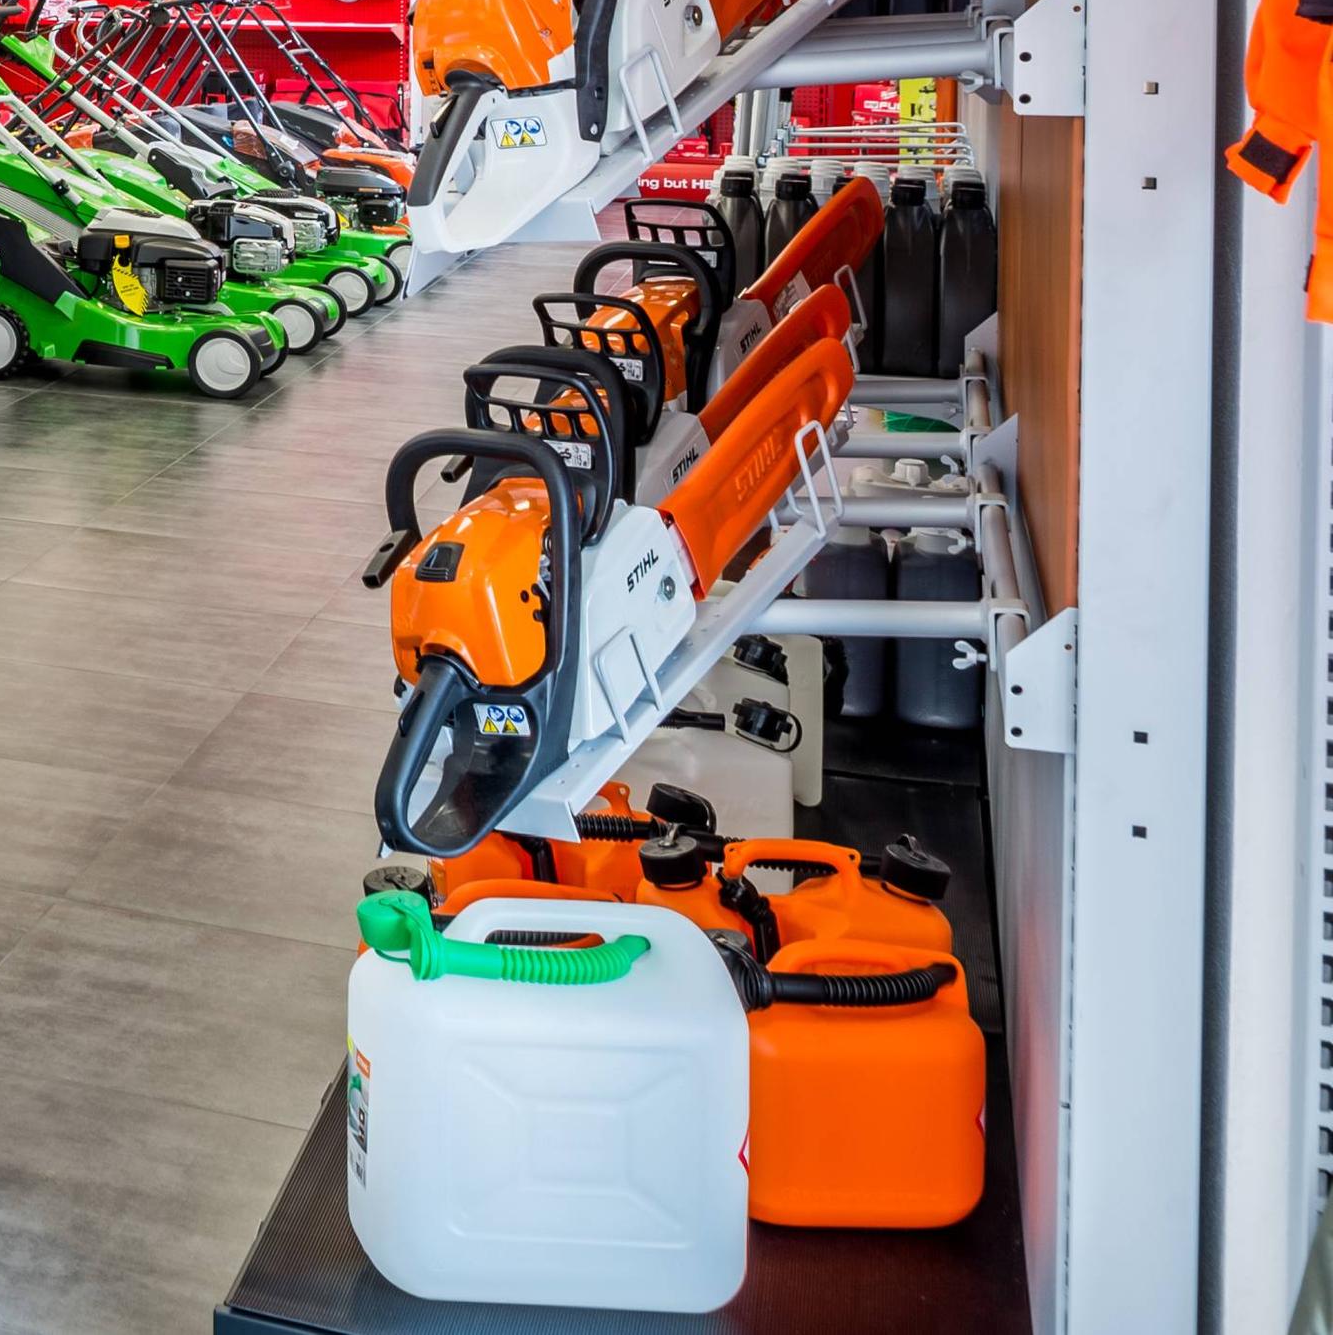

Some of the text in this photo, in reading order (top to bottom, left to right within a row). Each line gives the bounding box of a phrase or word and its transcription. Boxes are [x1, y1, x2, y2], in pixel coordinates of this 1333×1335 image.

[663, 178, 688, 191] but
[739, 322, 762, 354] STIHL
[672, 447, 699, 483] STIHL
[735, 432, 783, 502] STIHL
[627, 549, 659, 593] STIHL
